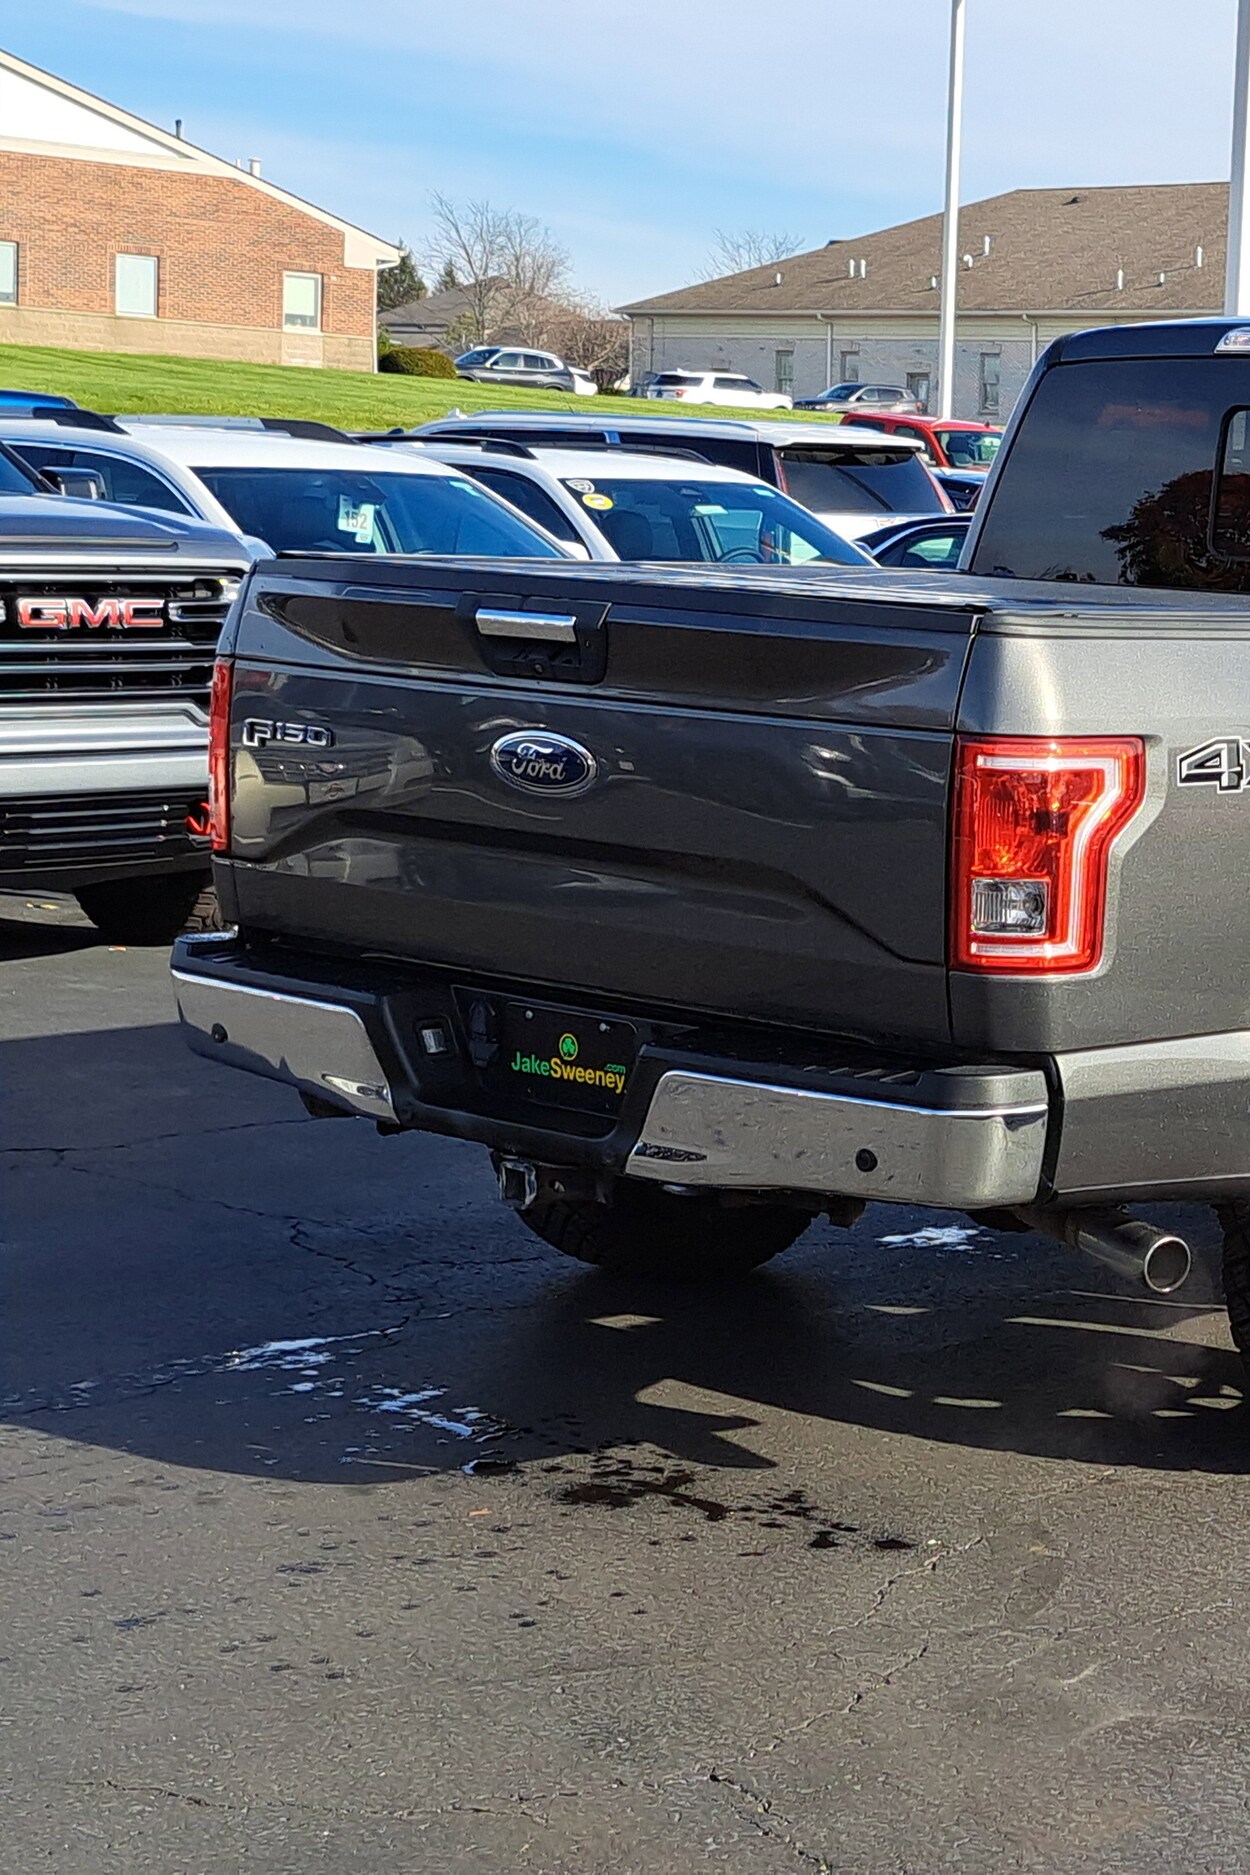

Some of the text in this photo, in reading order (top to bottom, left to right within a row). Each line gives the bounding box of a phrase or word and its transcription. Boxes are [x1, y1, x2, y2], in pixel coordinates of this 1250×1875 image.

[344, 510, 368, 530] 152
[18, 598, 165, 629] GMC
[511, 743, 568, 780] Ford
